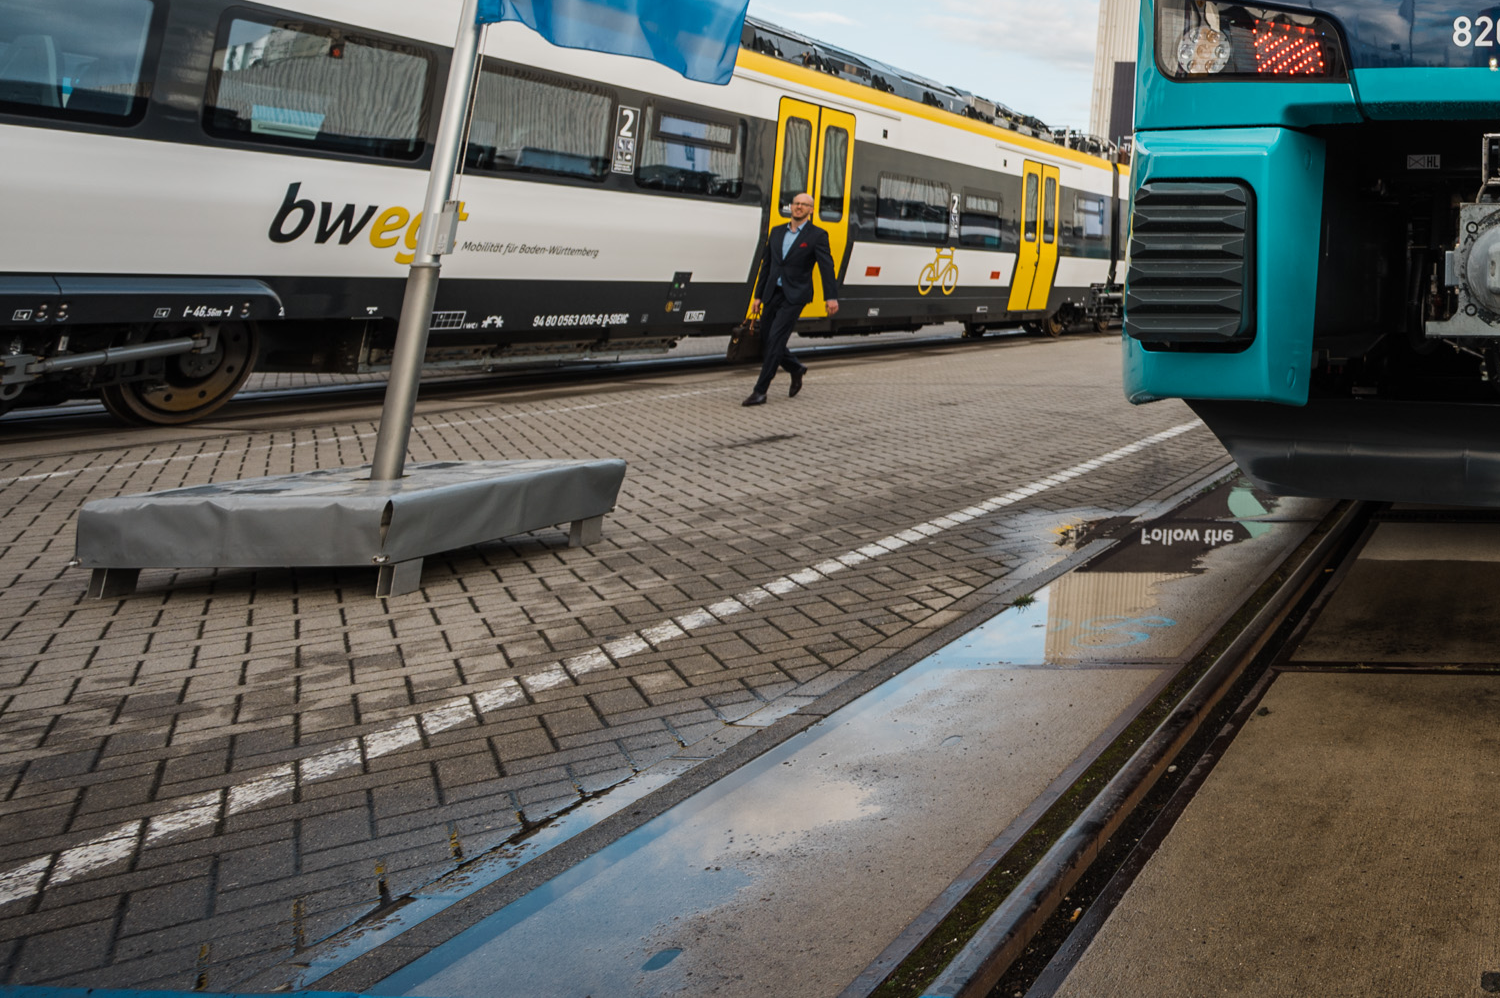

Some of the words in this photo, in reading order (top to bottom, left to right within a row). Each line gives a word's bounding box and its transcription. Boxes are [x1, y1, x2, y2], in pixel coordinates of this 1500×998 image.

[620, 109, 634, 137] 2
[1426, 156, 1439, 168] HL
[952, 195, 959, 214] 2
[461, 241, 504, 253] Mobilität
[502, 243, 519, 255] für
[519, 244, 599, 259] Baden-Württemberg
[532, 315, 545, 327] 94
[545, 314, 558, 327] 80
[557, 314, 580, 326] 0563
[579, 313, 603, 325] 006-6
